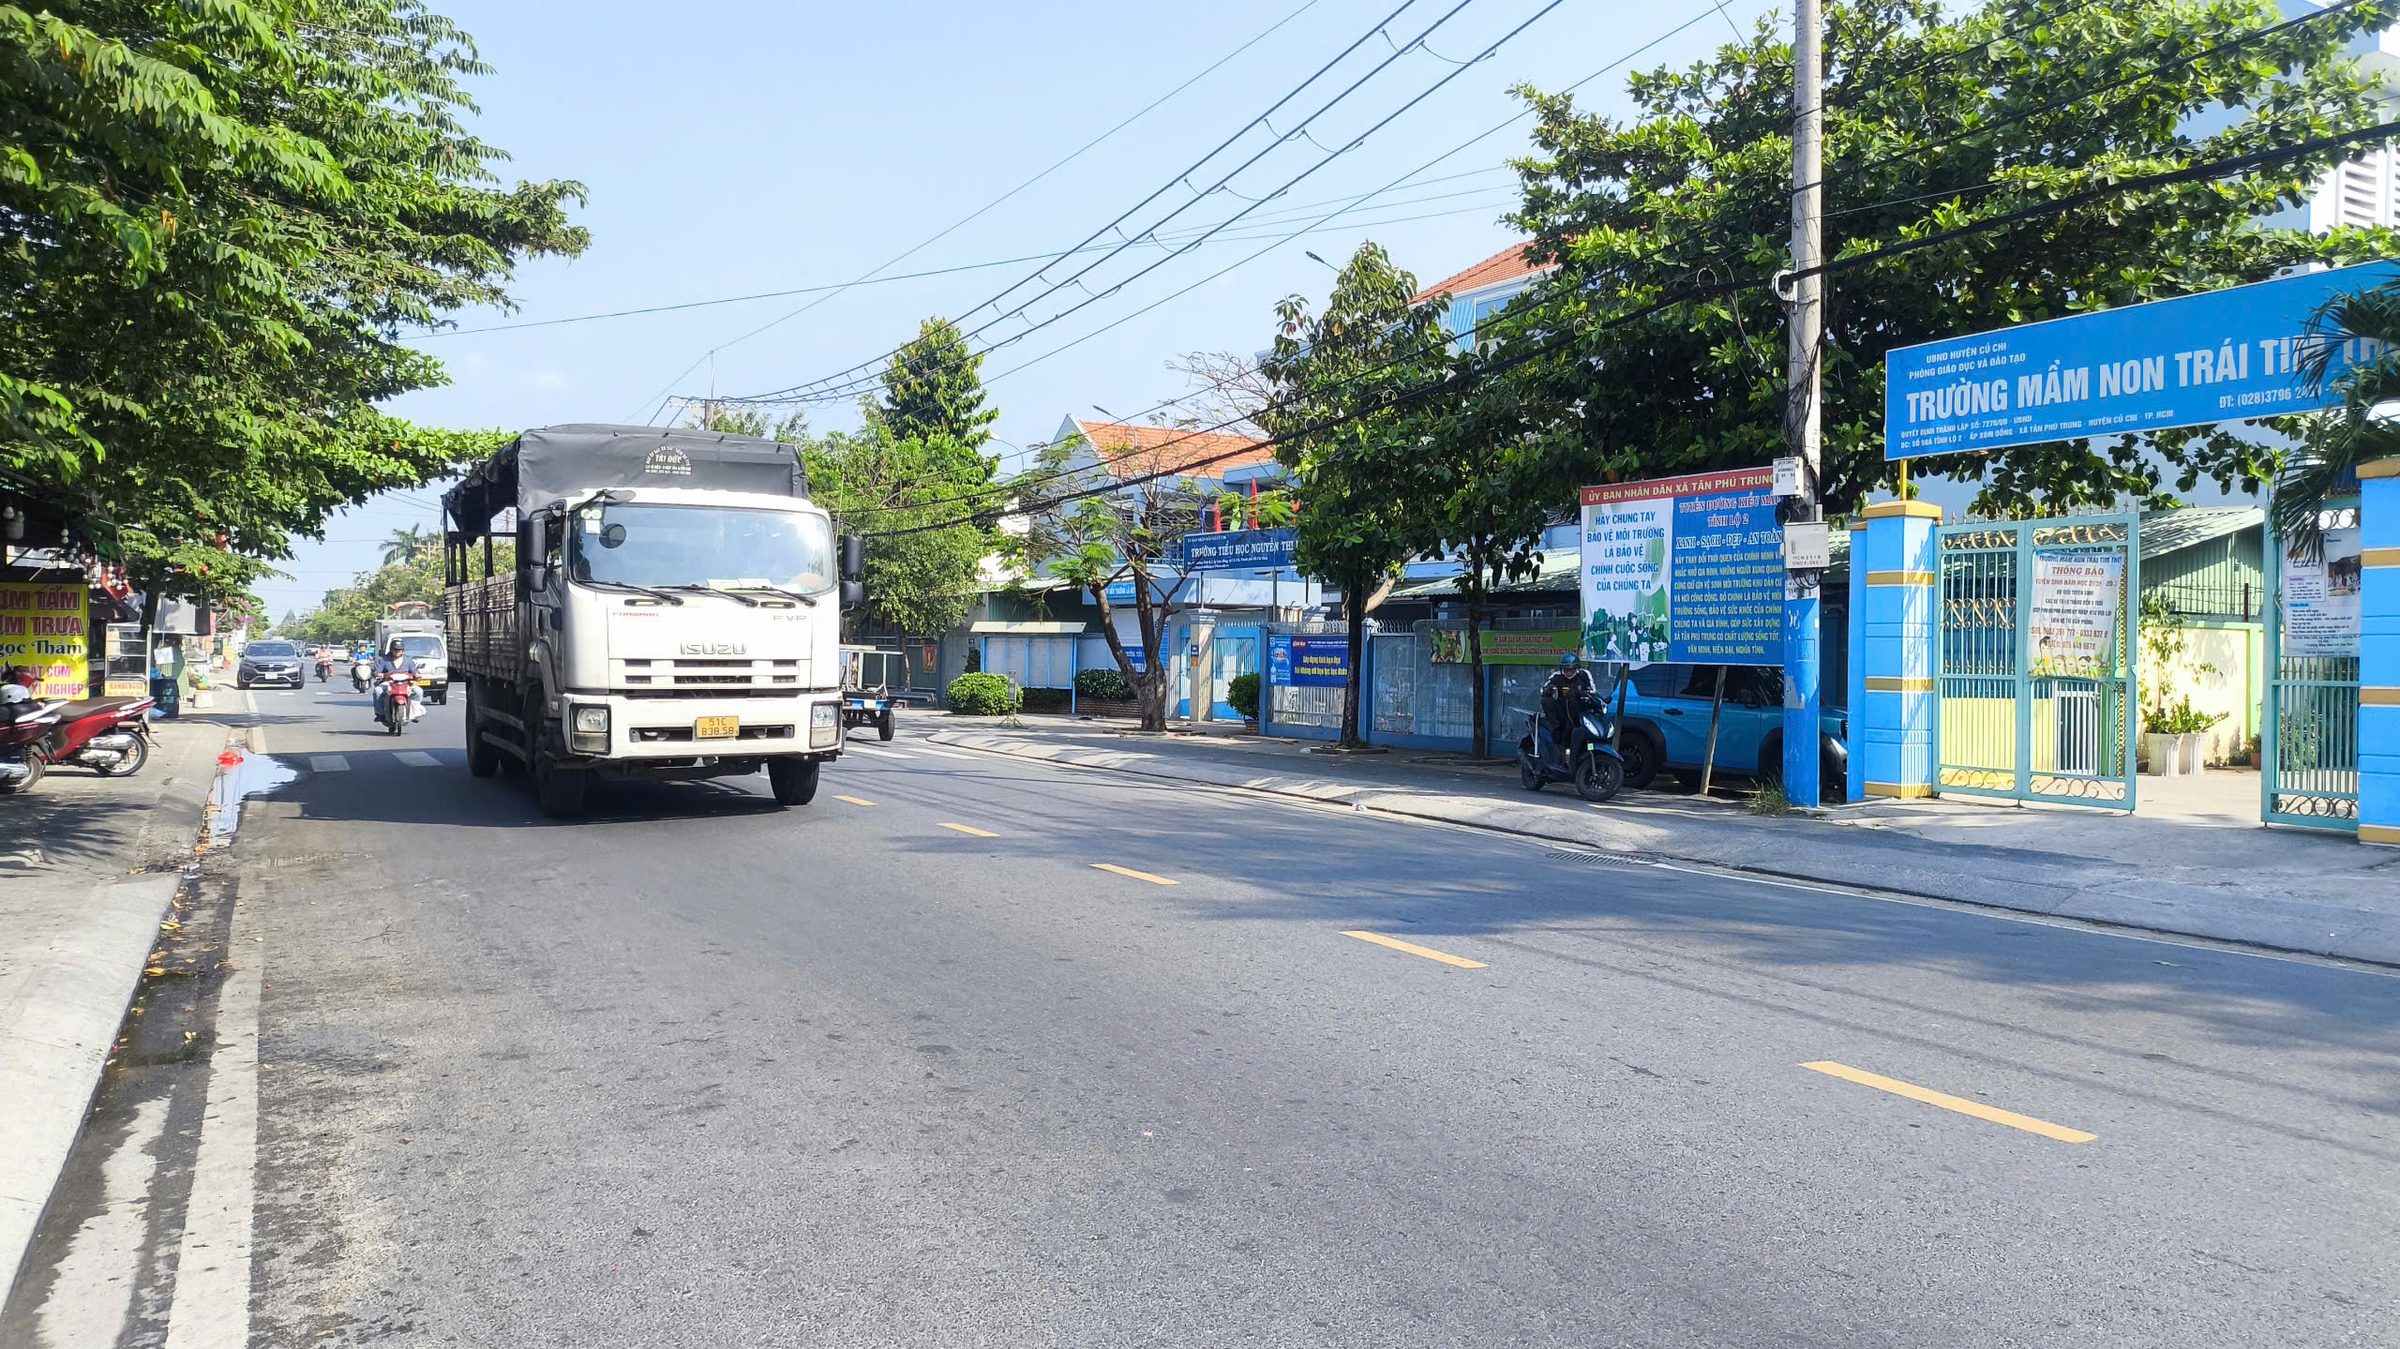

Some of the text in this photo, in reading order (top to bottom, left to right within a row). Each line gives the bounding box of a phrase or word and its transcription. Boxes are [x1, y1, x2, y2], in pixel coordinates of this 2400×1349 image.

[1926, 342, 2007, 363] UBND HUYỆN CỦ CHI
[1909, 353, 2026, 380] PHÒNG GIÁO DỤC VÀ ĐÀO TẠO
[1906, 377, 2008, 423] TRƯỜNG
[2099, 355, 2165, 398] NON
[2174, 337, 2248, 388] TRÁI
[2238, 387, 2292, 406] (028)3796
[2029, 424, 2043, 433] TÂN
[2044, 422, 2058, 431] PHÚ
[2060, 420, 2082, 430] TRUNG
[2088, 417, 2112, 428] HUYỆN
[2125, 414, 2138, 423] CHI
[1588, 489, 1600, 502] ỦY
[1603, 489, 1623, 501] BAN
[1624, 488, 1650, 499] NHÂN
[1652, 484, 1673, 496] DÂN
[1675, 482, 1689, 493] XÃ
[1692, 480, 1712, 491] TÂN
[1715, 476, 1736, 489] PHÚ
[1595, 511, 1656, 526] HÃY CHUNG TAY
[1707, 514, 1749, 529] TỈNH LỘ 2
[1587, 526, 1665, 542] BẢO VỆ MÔI TRƯỜNG
[1675, 527, 1782, 550] XANH SẠCH ĐẸP AN TOÀN
[1191, 544, 1217, 558] TRƯỜNG
[1218, 540, 1234, 556] TIỂU
[1235, 543, 1250, 557] HỌC
[1251, 537, 1280, 553] NGUYỄN
[1604, 544, 1644, 558] LÀ BẢO VỆ
[1591, 559, 1659, 575] CHÍNH CUỘC SỐNG
[2051, 565, 2105, 576] THÔNG BÁO
[1597, 577, 1651, 591] CỦA CHÚNG TA
[36, 585, 80, 610] TẤM
[31, 615, 84, 636] TRƯA
[1691, 619, 1698, 628] TA
[680, 642, 747, 655] ISUZU
[709, 717, 727, 727] 51C
